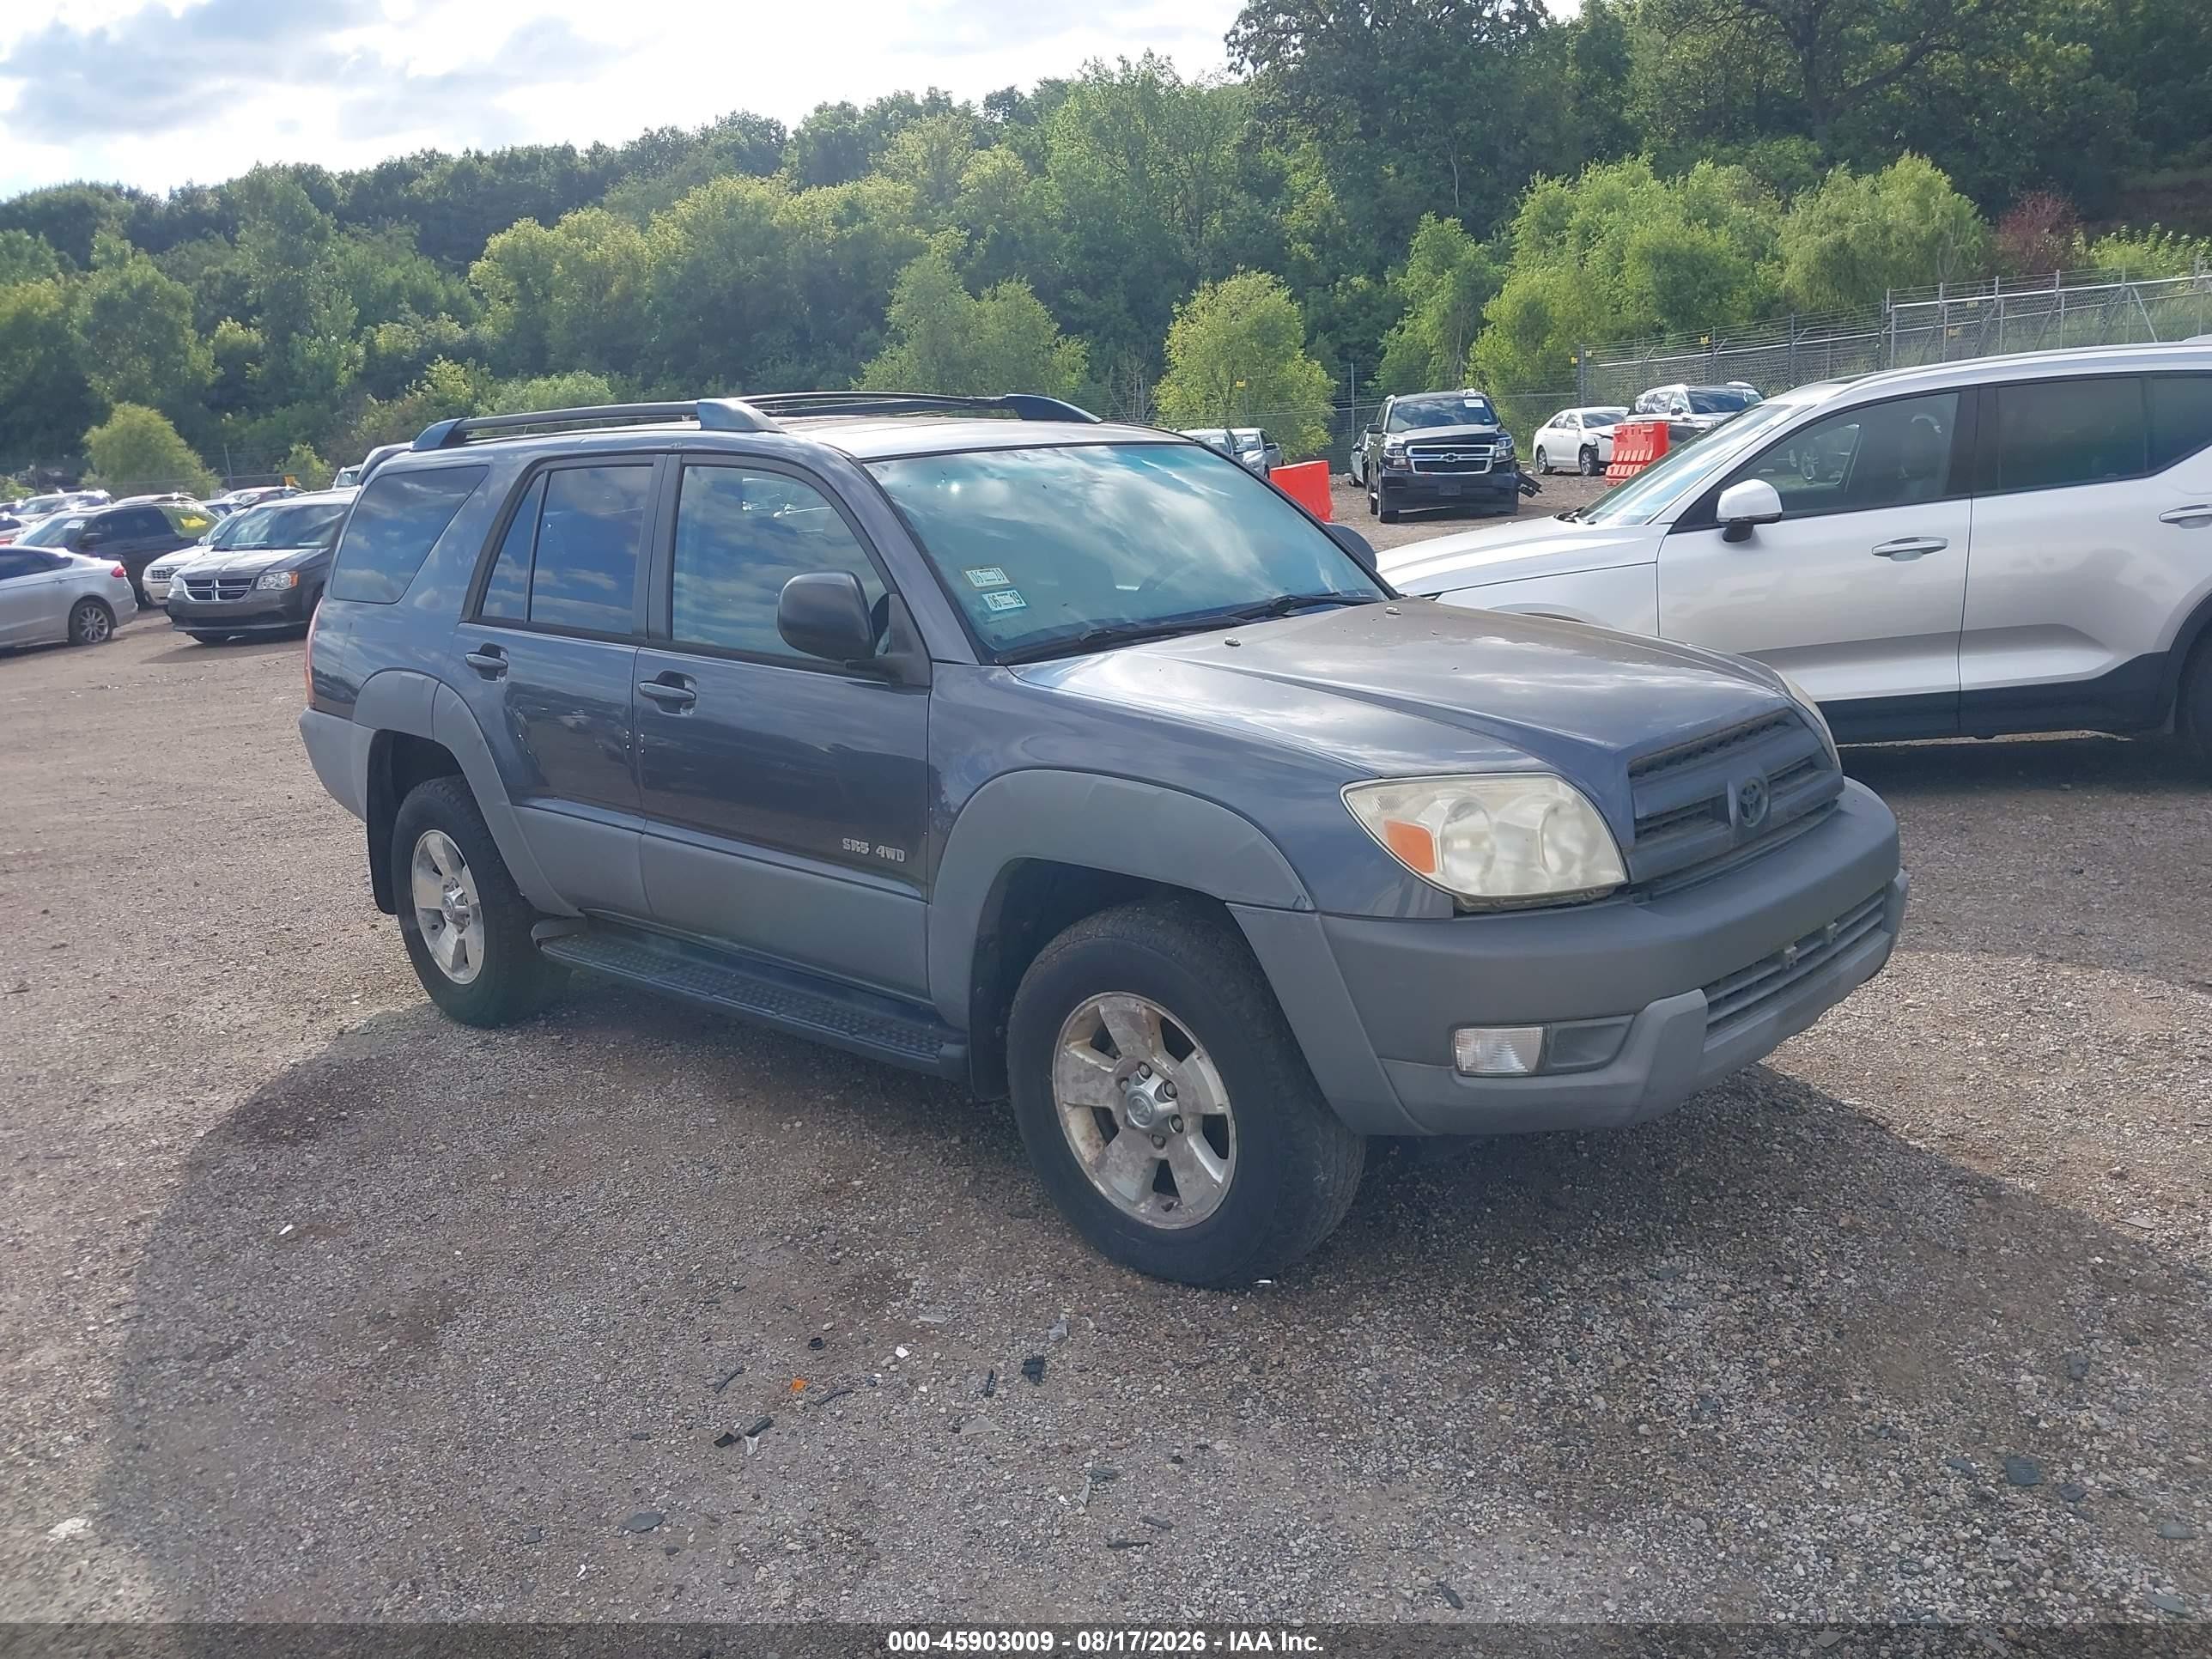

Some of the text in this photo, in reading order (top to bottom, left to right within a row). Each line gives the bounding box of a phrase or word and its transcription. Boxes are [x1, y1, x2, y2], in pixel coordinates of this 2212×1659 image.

[988, 591, 1023, 608] 06 19
[842, 837, 905, 863] SR5 4WD
